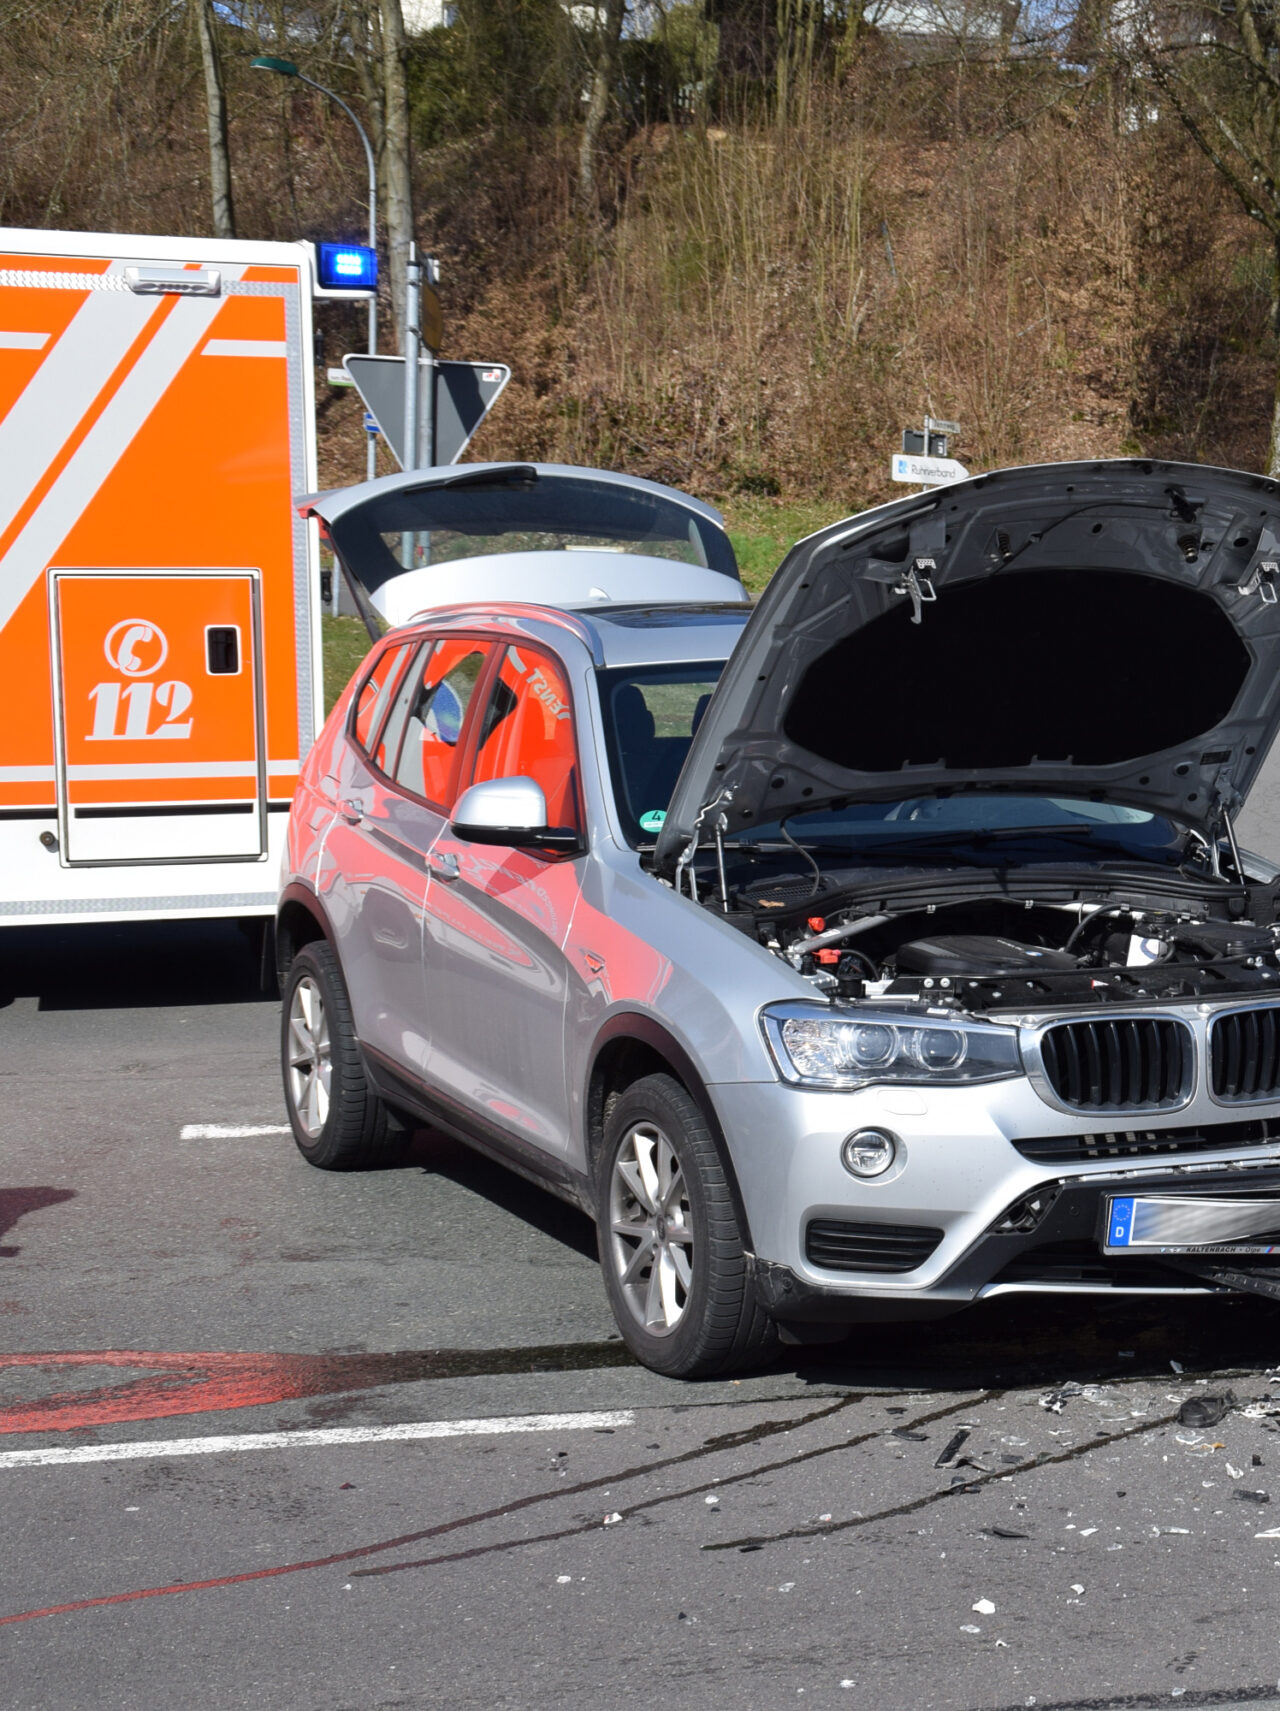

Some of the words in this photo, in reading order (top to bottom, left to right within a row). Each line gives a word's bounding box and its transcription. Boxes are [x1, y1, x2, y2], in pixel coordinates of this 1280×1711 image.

[84, 680, 194, 741] 112
[651, 810, 661, 821] 4
[1115, 1226, 1124, 1238] D
